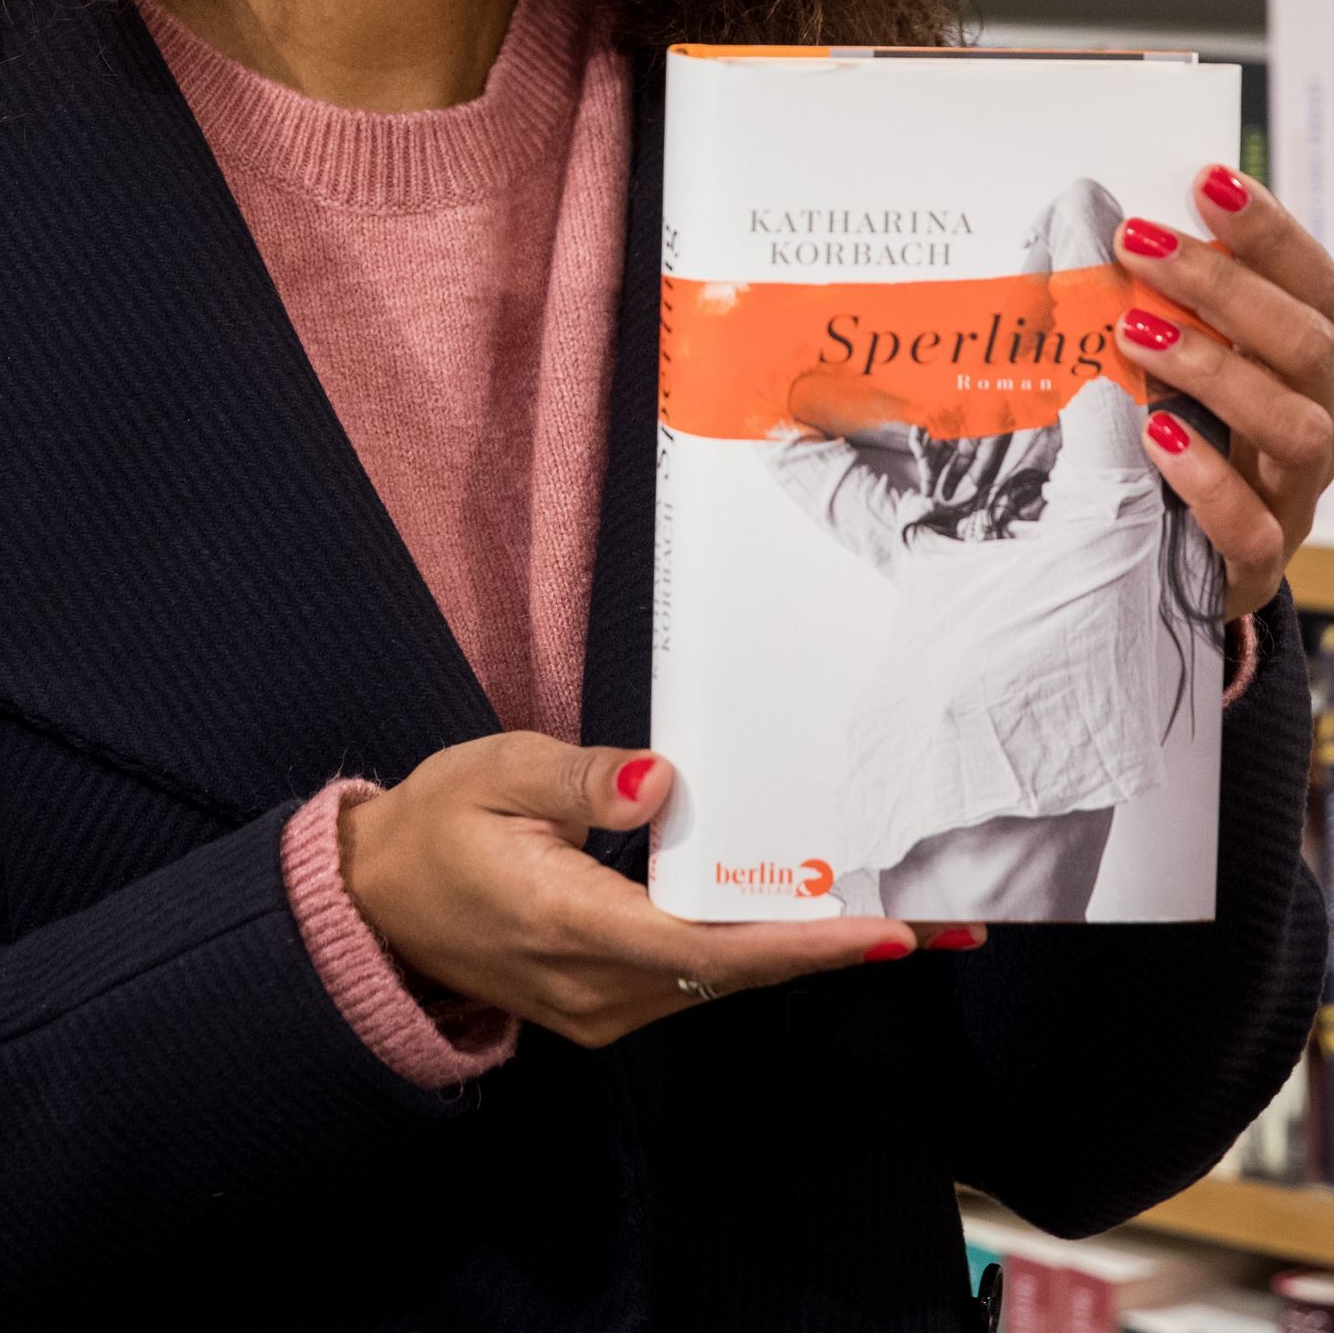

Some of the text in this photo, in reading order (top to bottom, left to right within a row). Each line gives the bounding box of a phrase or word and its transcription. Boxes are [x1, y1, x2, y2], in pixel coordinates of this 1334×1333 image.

[750, 209, 974, 235] KATHARINA
[770, 241, 952, 266] KORBACH
[819, 313, 1114, 376] Sperling
[957, 374, 1053, 391] Roman
[715, 861, 793, 884] berlin
